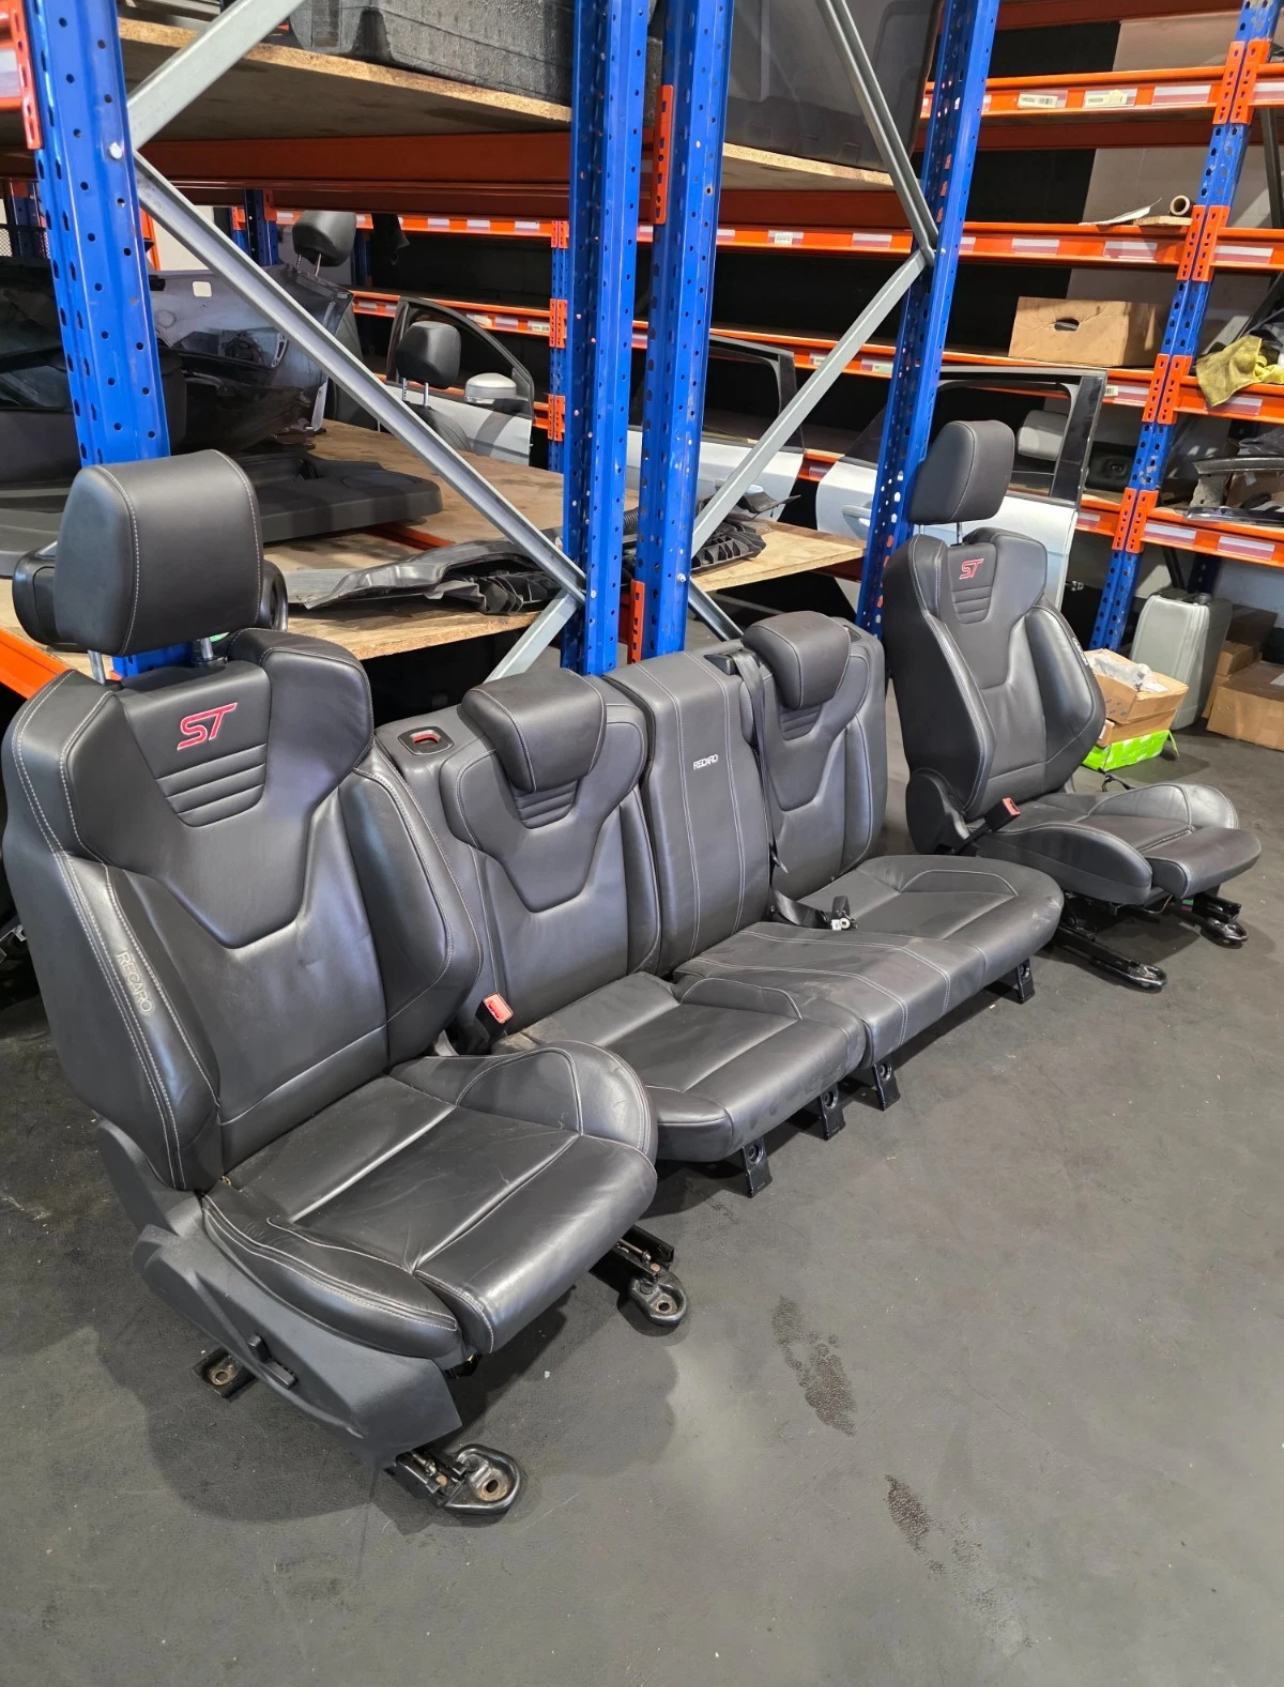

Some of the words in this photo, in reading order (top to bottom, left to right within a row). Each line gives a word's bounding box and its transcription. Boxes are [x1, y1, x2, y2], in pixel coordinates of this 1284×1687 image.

[959, 558, 984, 580] ST
[177, 702, 238, 751] ST
[117, 951, 152, 1012] RECARO
